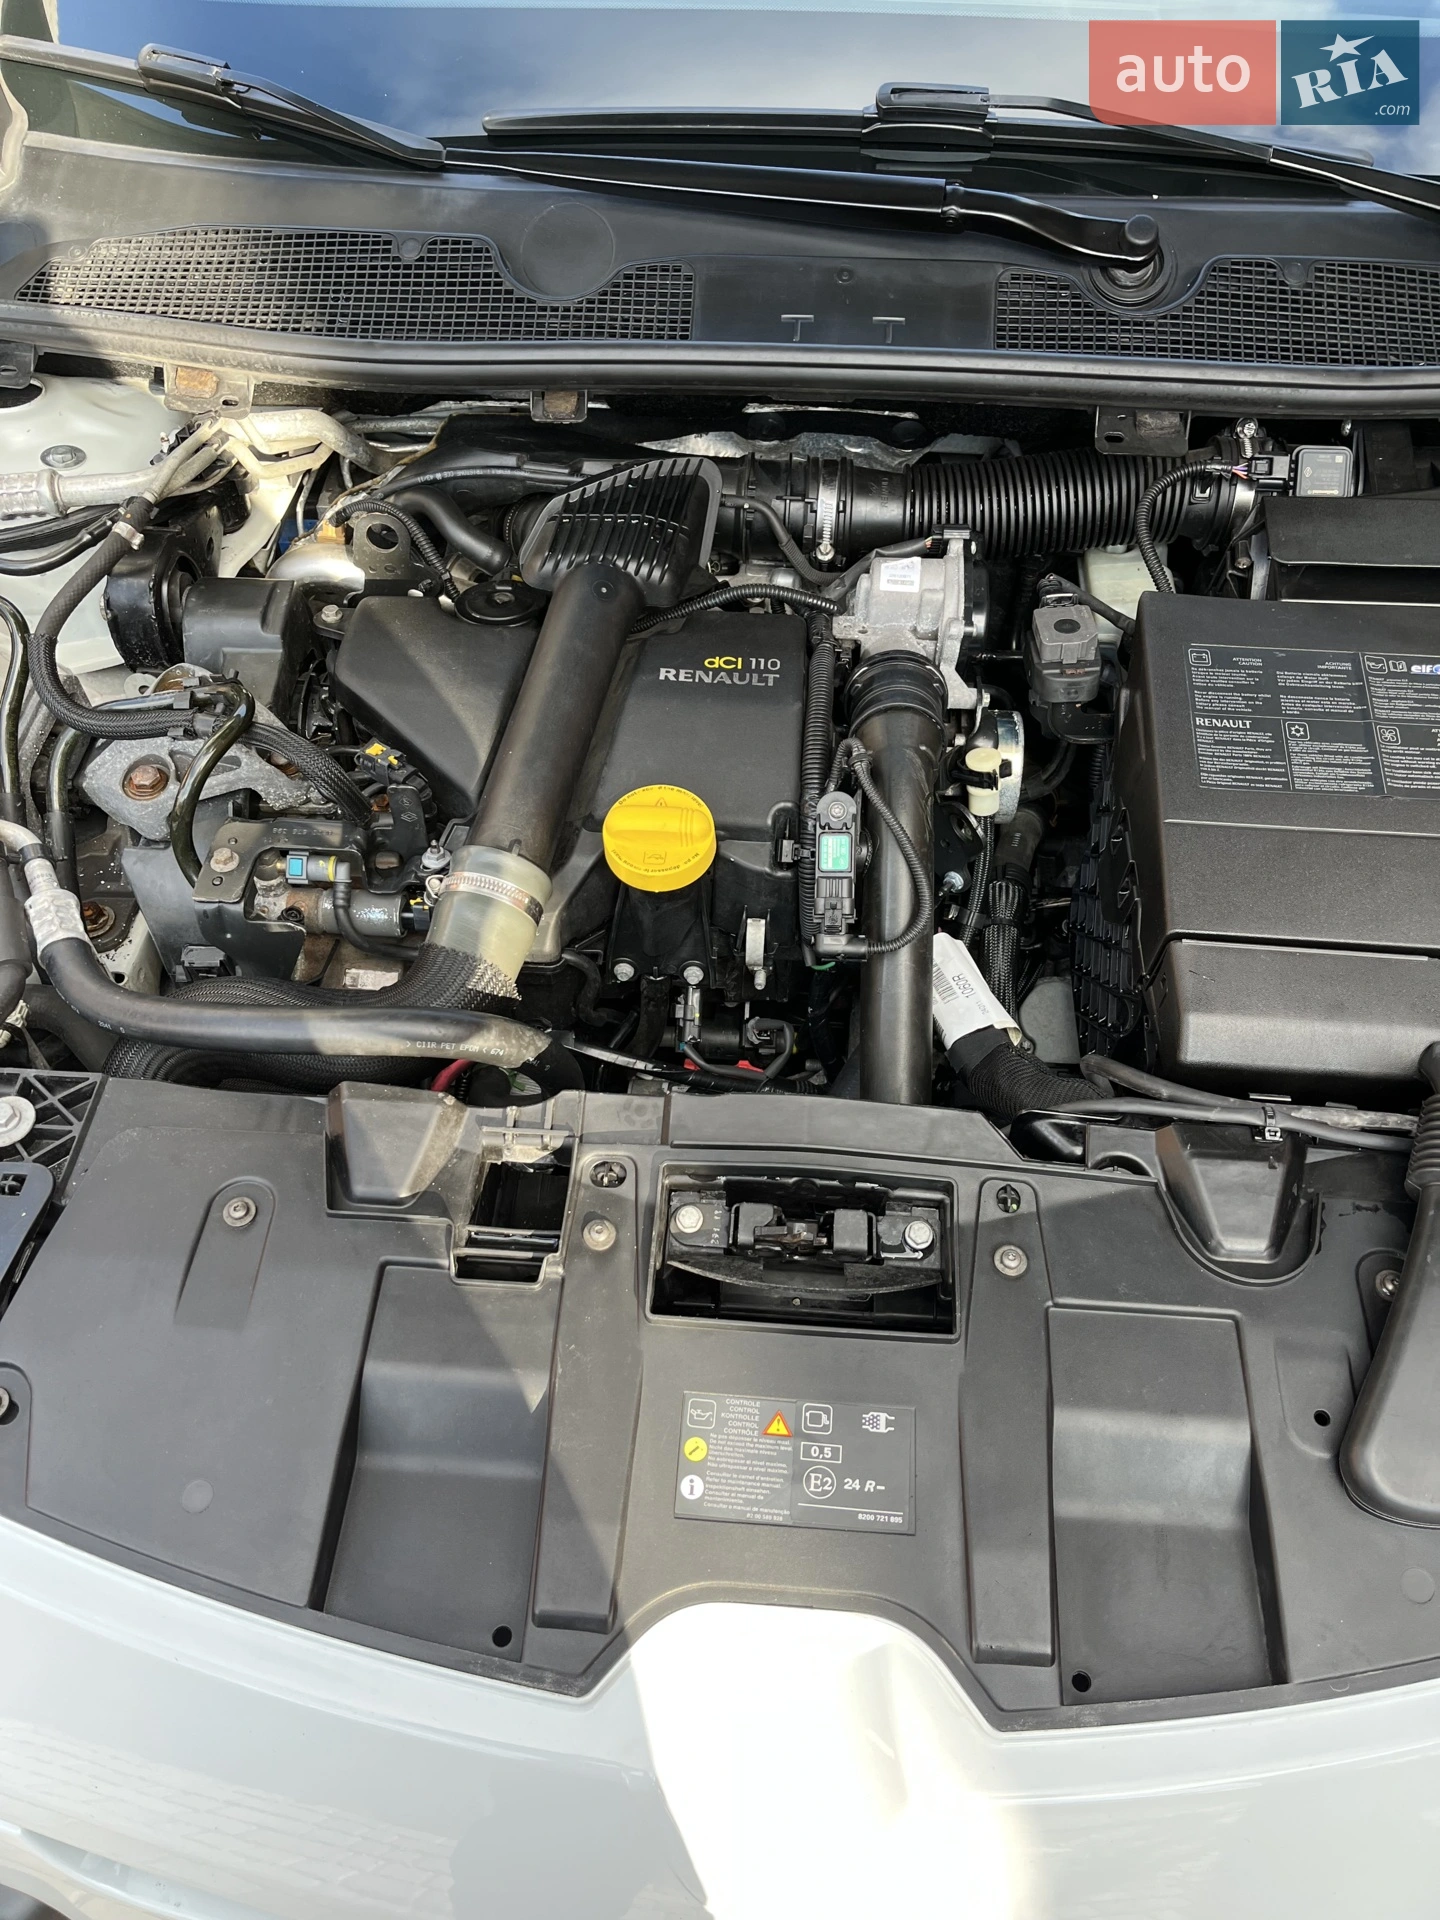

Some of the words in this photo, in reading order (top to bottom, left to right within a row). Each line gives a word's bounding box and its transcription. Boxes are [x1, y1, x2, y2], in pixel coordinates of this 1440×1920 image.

[750, 658, 780, 671] 110
[659, 668, 780, 686] RENAULT
[1196, 717, 1252, 728] RENAULT
[952, 973, 976, 998] 1060R
[730, 1406, 760, 1414] CONTROL
[721, 1412, 759, 1421] KONTROLLE
[728, 1420, 759, 1429] CONTROL
[724, 1428, 759, 1436] CONTRÔLE
[811, 1446, 832, 1459] 0,5
[809, 1472, 832, 1492] E2
[843, 1478, 860, 1491] 24
[876, 1514, 888, 1522] 721
